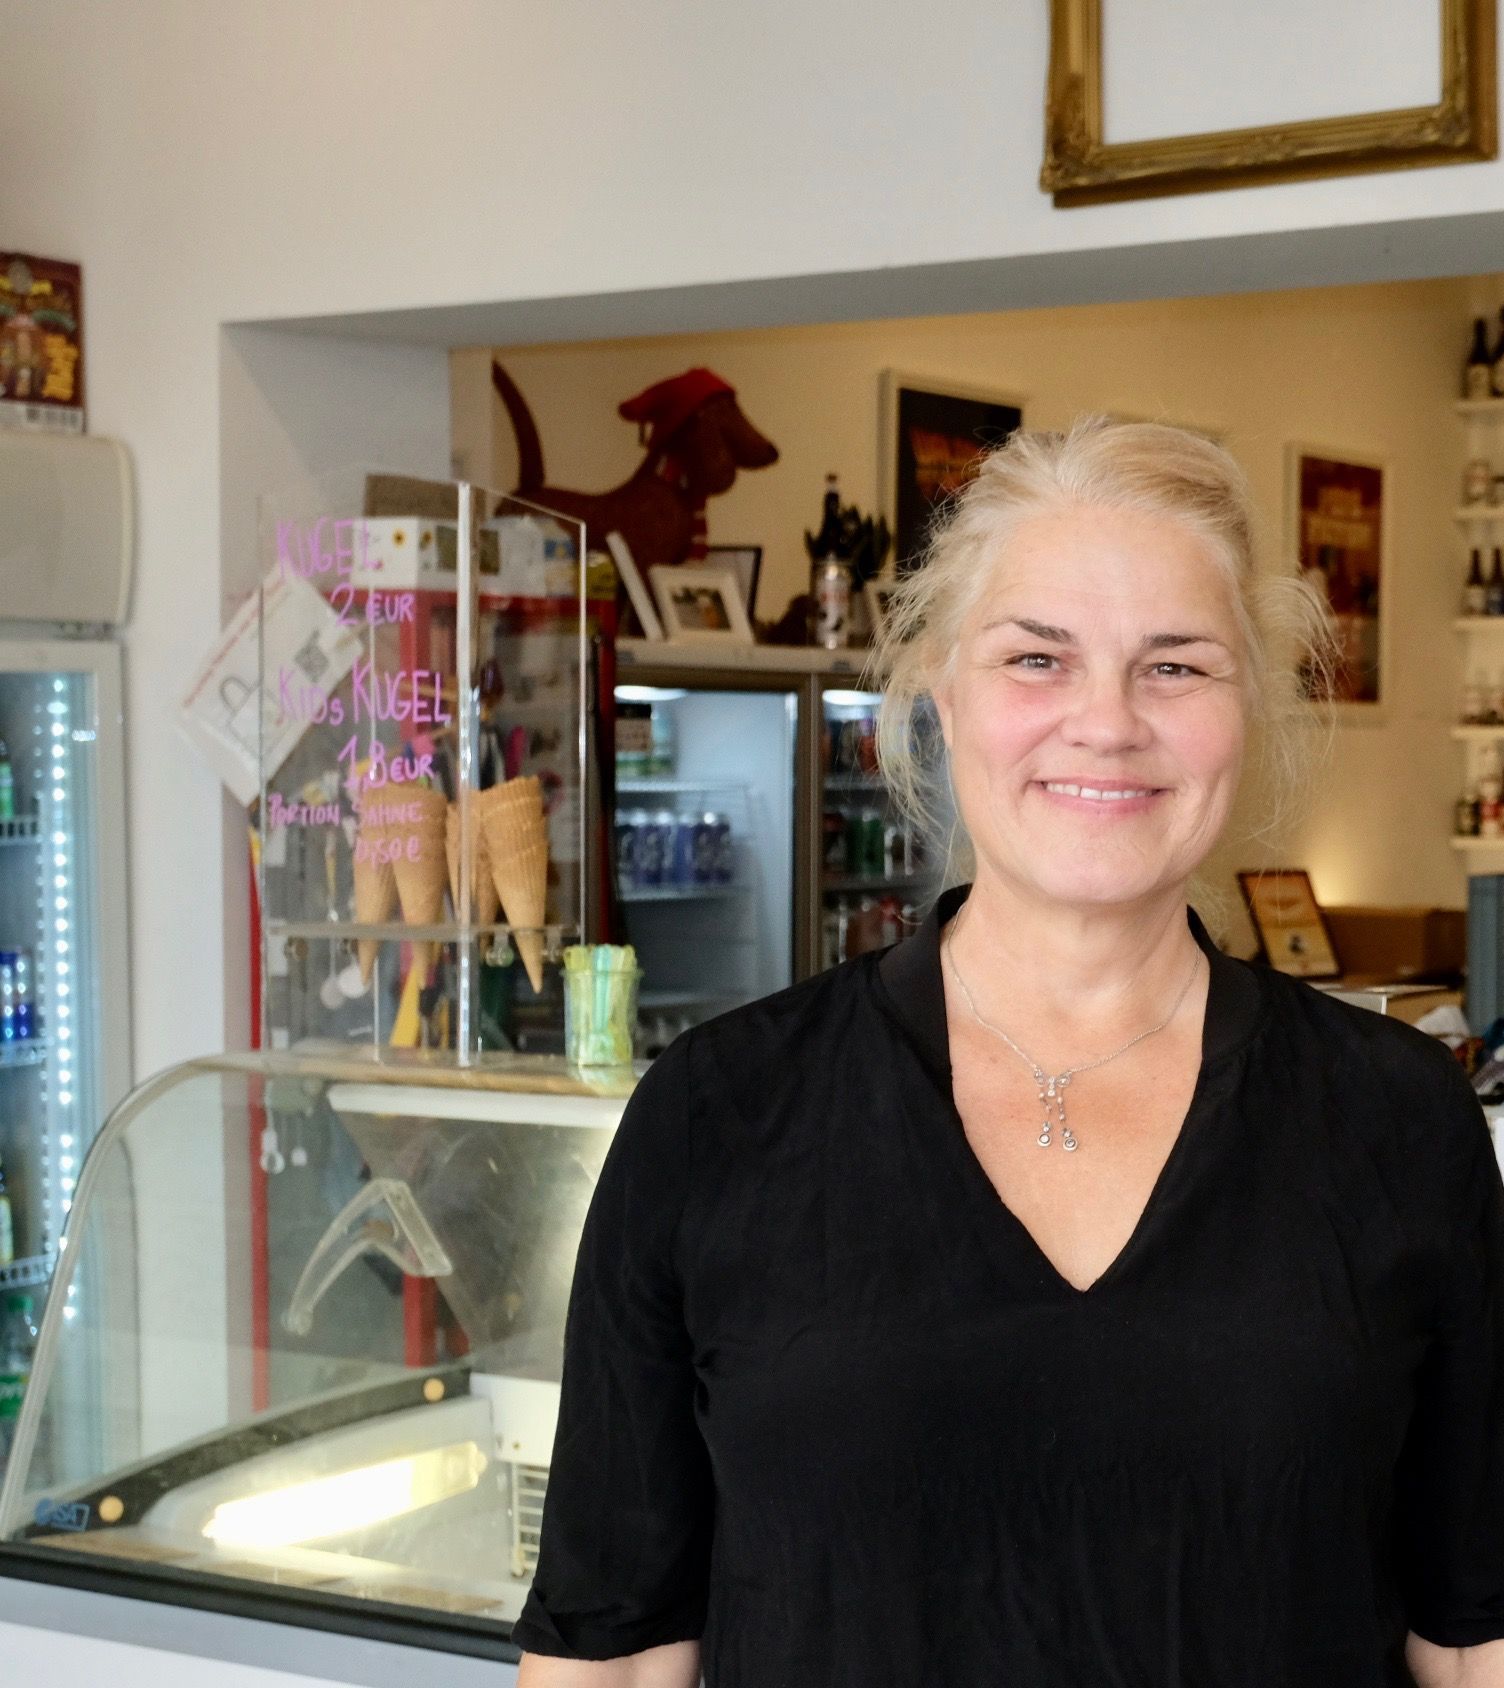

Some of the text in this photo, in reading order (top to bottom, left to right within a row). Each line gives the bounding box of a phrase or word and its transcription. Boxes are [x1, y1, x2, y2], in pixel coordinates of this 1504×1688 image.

[330, 582, 416, 627] 2 EUR
[352, 656, 452, 724] KUGEL
